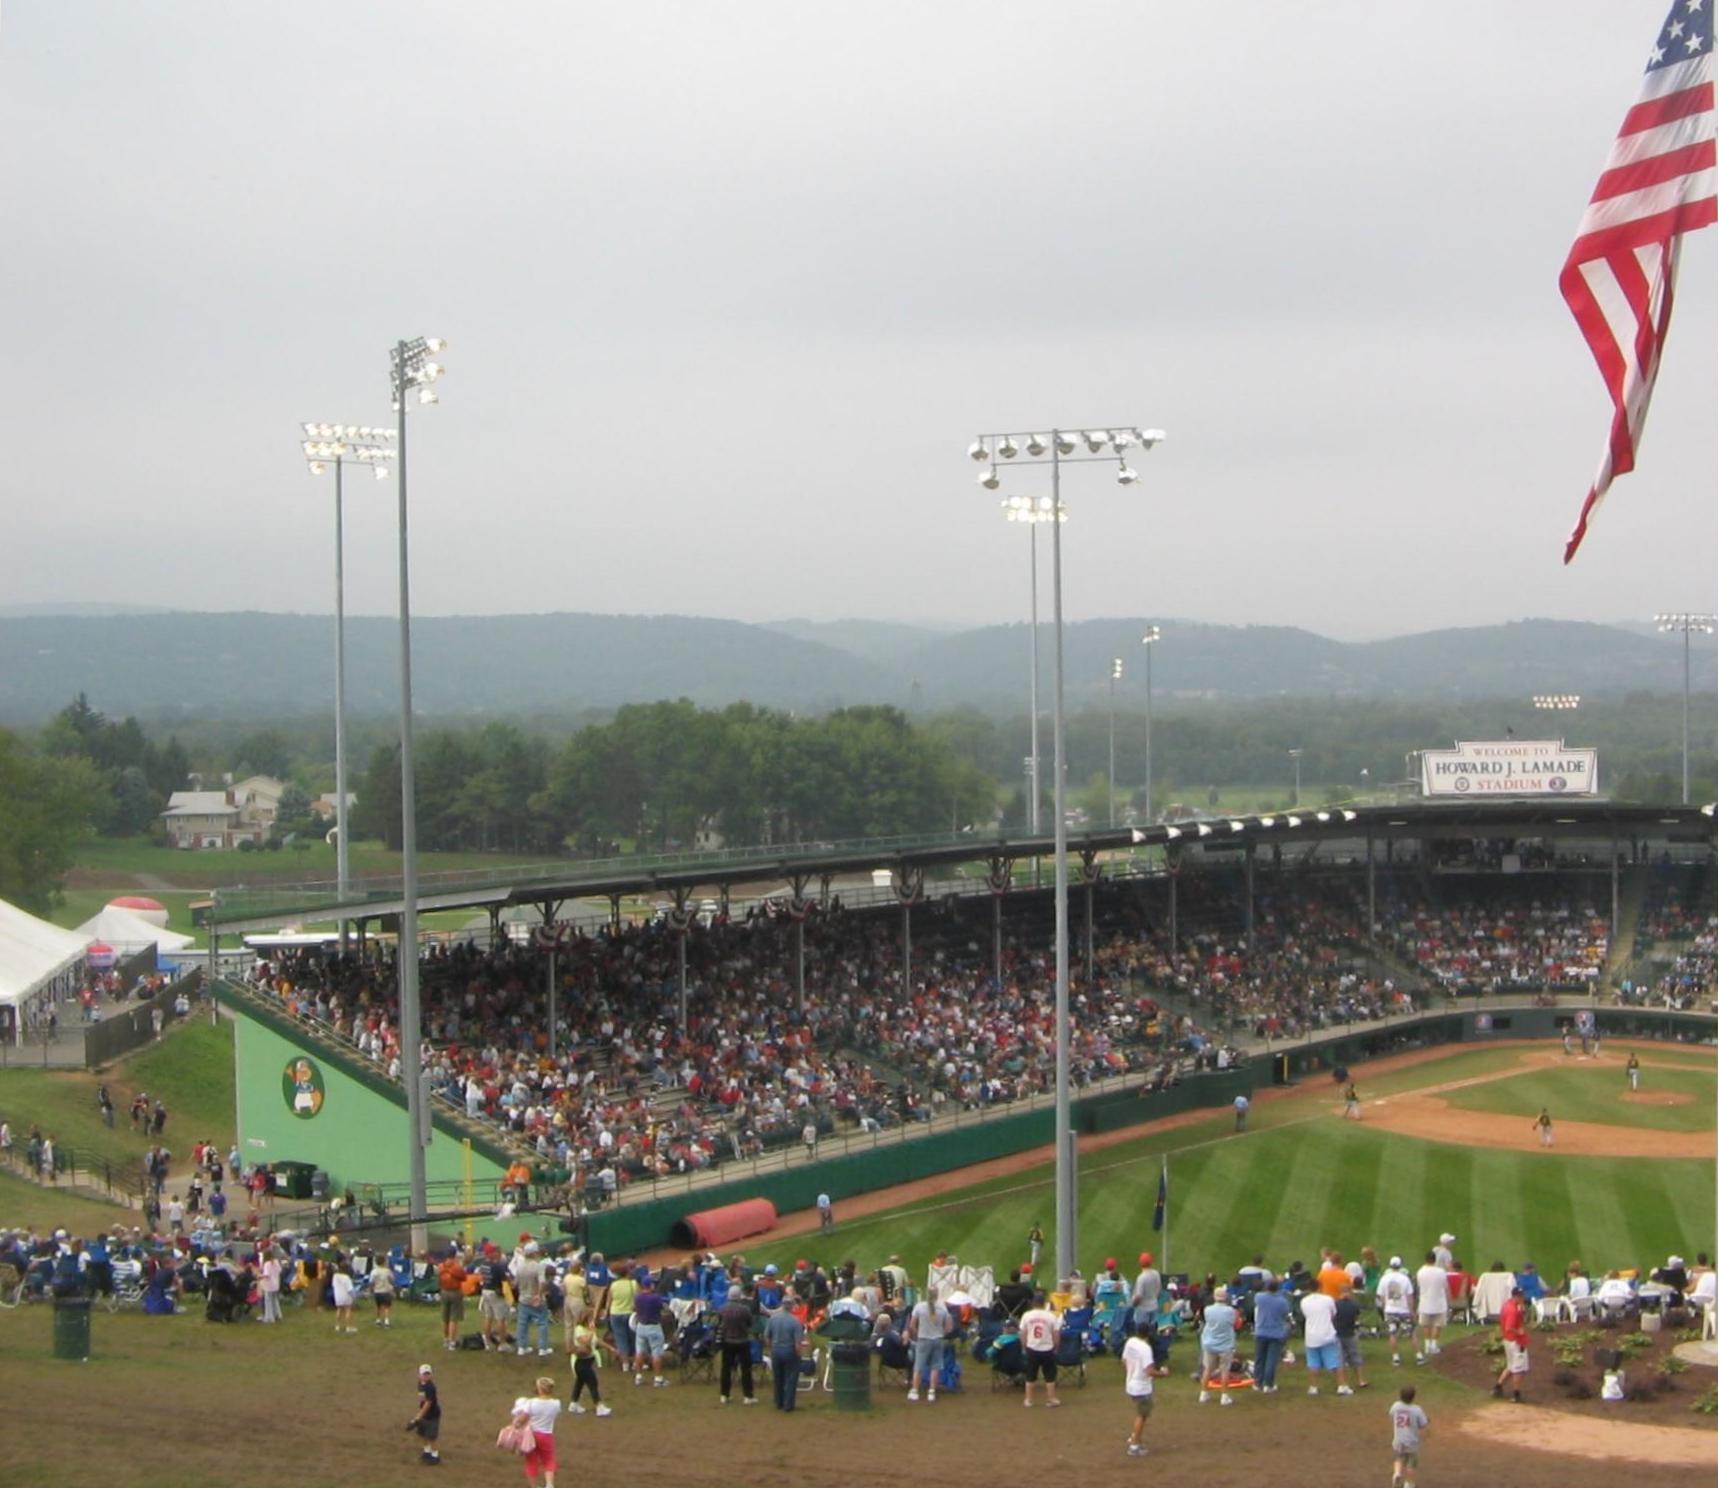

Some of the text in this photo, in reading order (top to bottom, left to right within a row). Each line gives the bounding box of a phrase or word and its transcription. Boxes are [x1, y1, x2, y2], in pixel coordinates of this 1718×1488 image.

[1474, 748, 1549, 756] WELCOME TO
[1436, 761, 1585, 777] HOWARD J. LAMADE
[1477, 779, 1542, 790] STADIUM
[1033, 1326, 1043, 1339] 6
